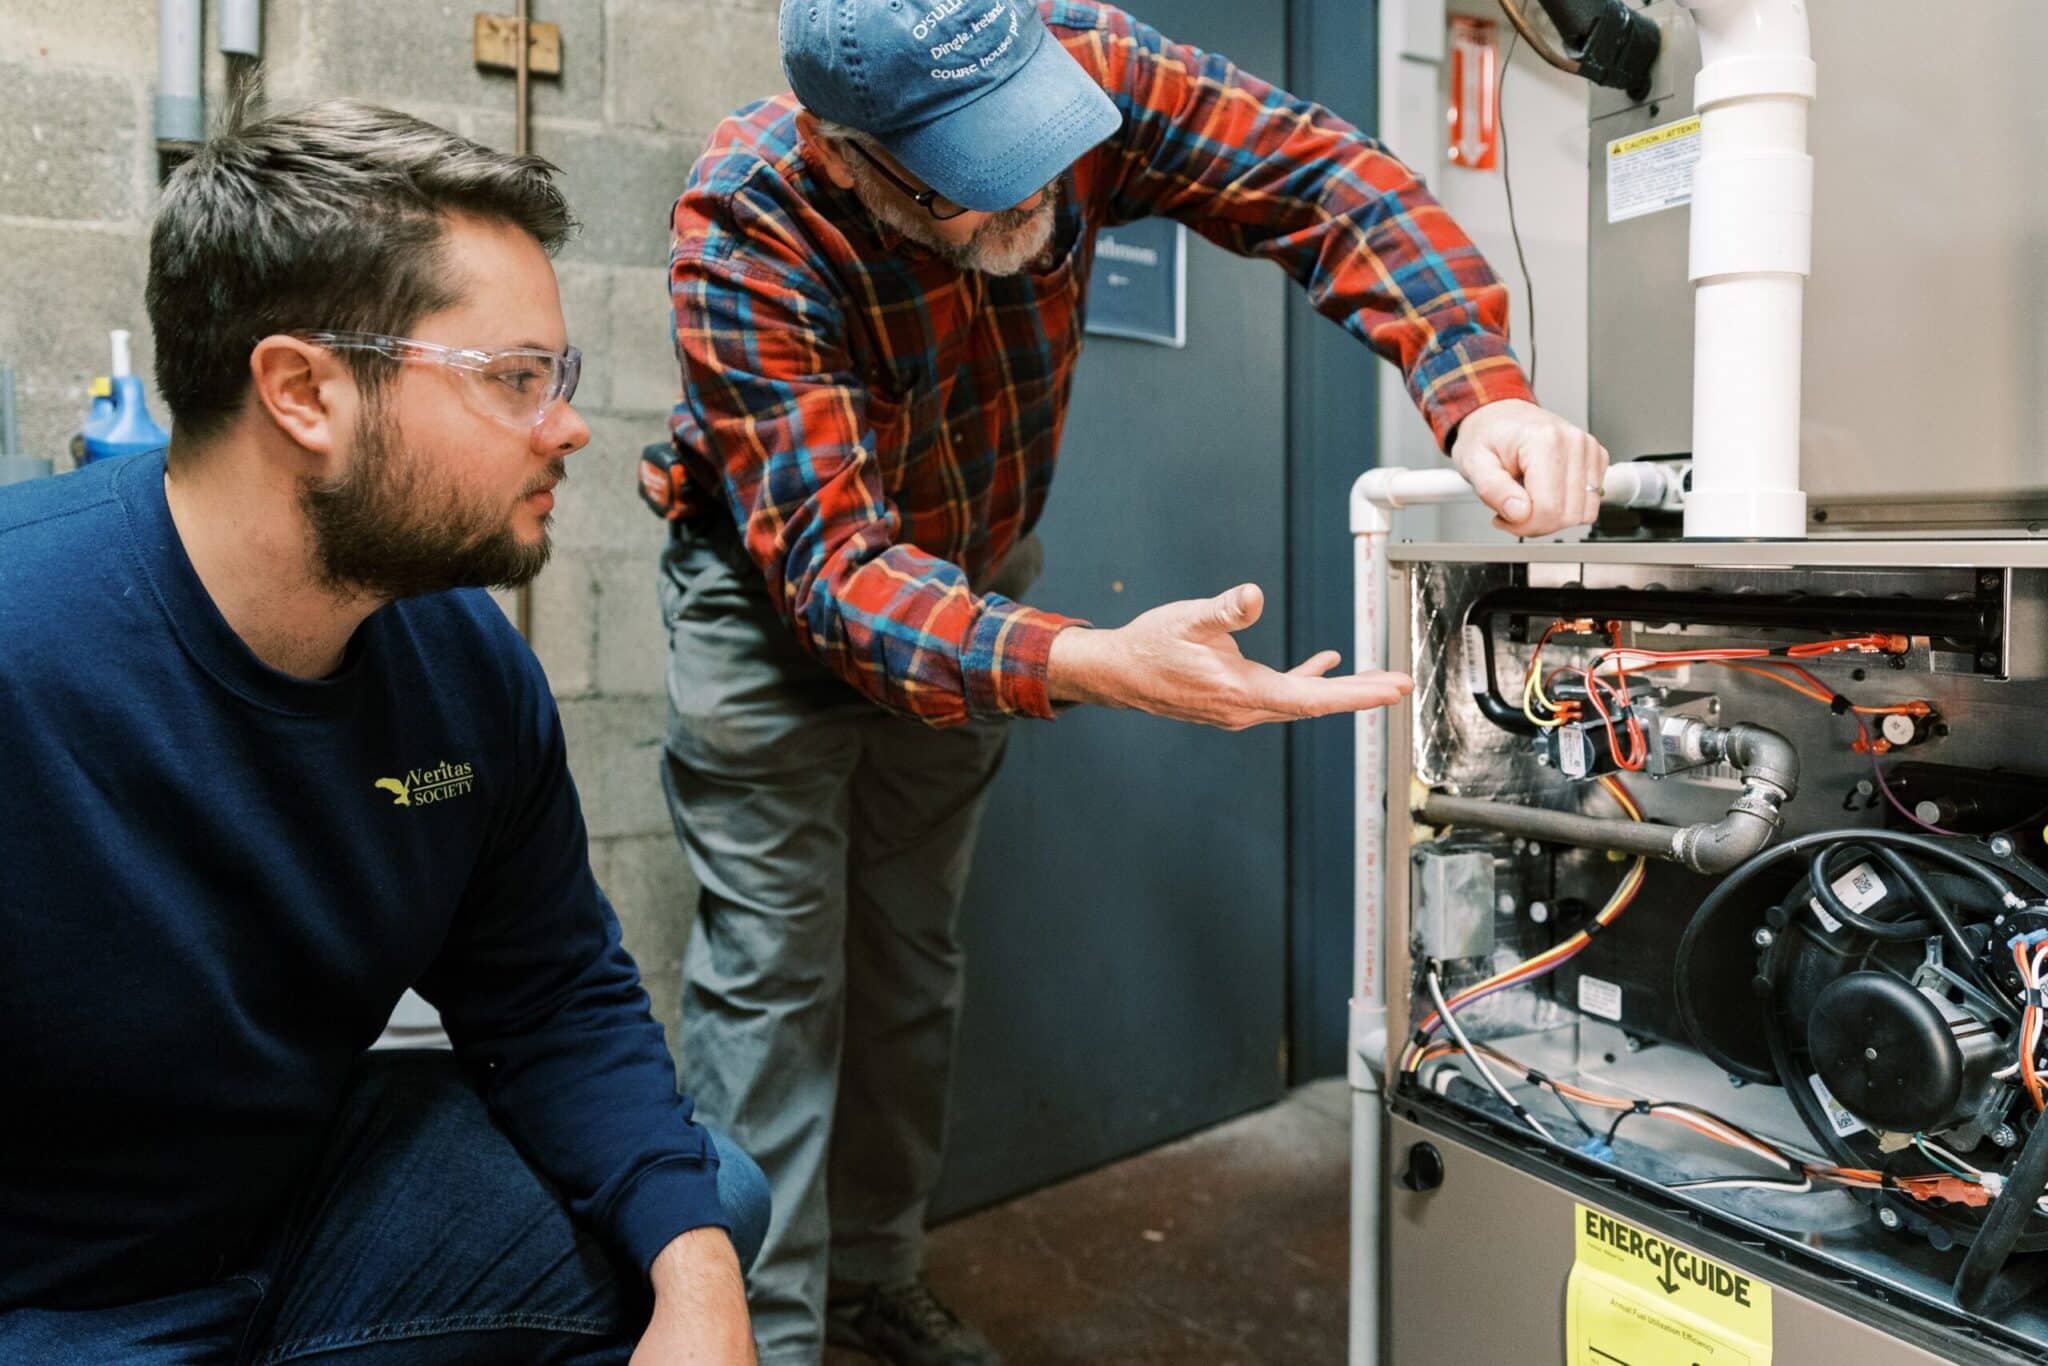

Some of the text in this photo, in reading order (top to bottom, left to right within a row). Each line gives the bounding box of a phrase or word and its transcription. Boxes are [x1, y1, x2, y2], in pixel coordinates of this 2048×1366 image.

[912, 0, 964, 40] O'SULL
[929, 32, 974, 60] Dingle,
[979, 35, 1013, 68] house
[1624, 135, 1660, 150] CAUTION
[409, 760, 472, 786] Veritas
[415, 779, 473, 806] SOCIETY
[1585, 1210, 1751, 1309] ENERGYGUIDE
